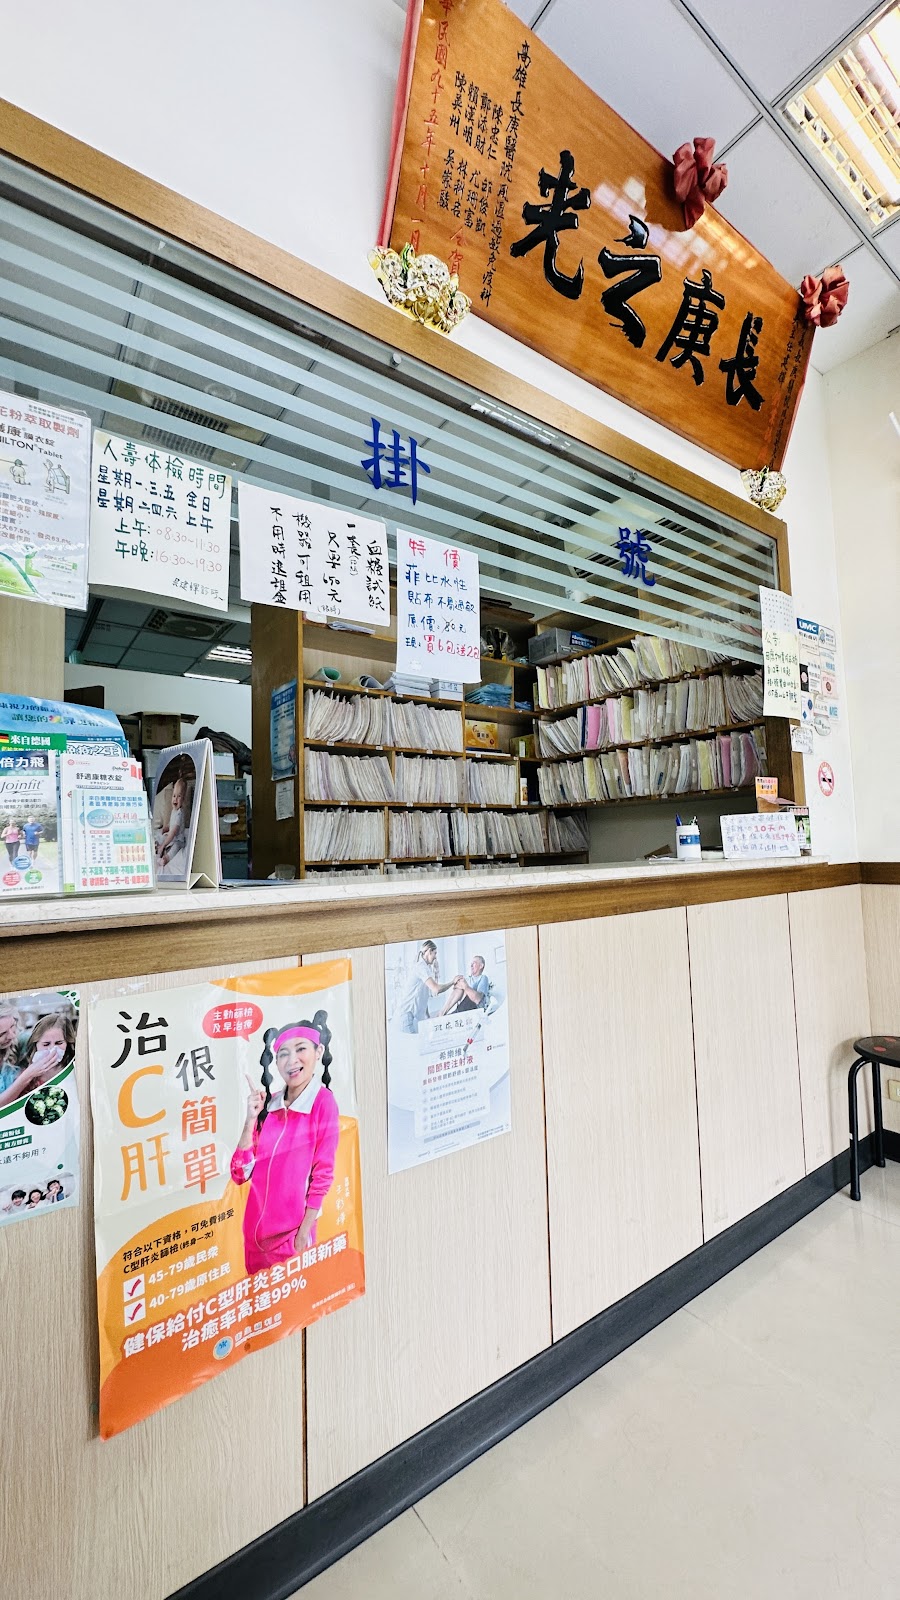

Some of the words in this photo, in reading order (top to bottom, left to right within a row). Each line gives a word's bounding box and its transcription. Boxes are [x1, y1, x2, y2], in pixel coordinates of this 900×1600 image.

[510, 150, 765, 411] 長庚之光
[38, 447, 63, 459] Tablet
[186, 490, 210, 512] 全日
[361, 417, 431, 506] 掛
[617, 526, 656, 587] 號
[186, 511, 214, 533] 上午
[292, 512, 314, 605] 機器可租用
[408, 537, 461, 571] 特價
[799, 621, 818, 632] UMC
[11, 735, 51, 746] 來自德國
[0, 756, 45, 768] 倍力飛
[0, 779, 41, 793] Joinfit
[212, 1007, 254, 1021] 主動篩檢
[212, 1019, 253, 1034] 及早治療
[175, 1045, 220, 1195] 很簡單
[0, 1147, 46, 1165] 遠不夠用？
[123, 1233, 348, 1358] 健保給付C型肝炎全口服新藥
[149, 1262, 231, 1309] 40-79歲原住民
[181, 1275, 307, 1352] 治癒率高達99%
